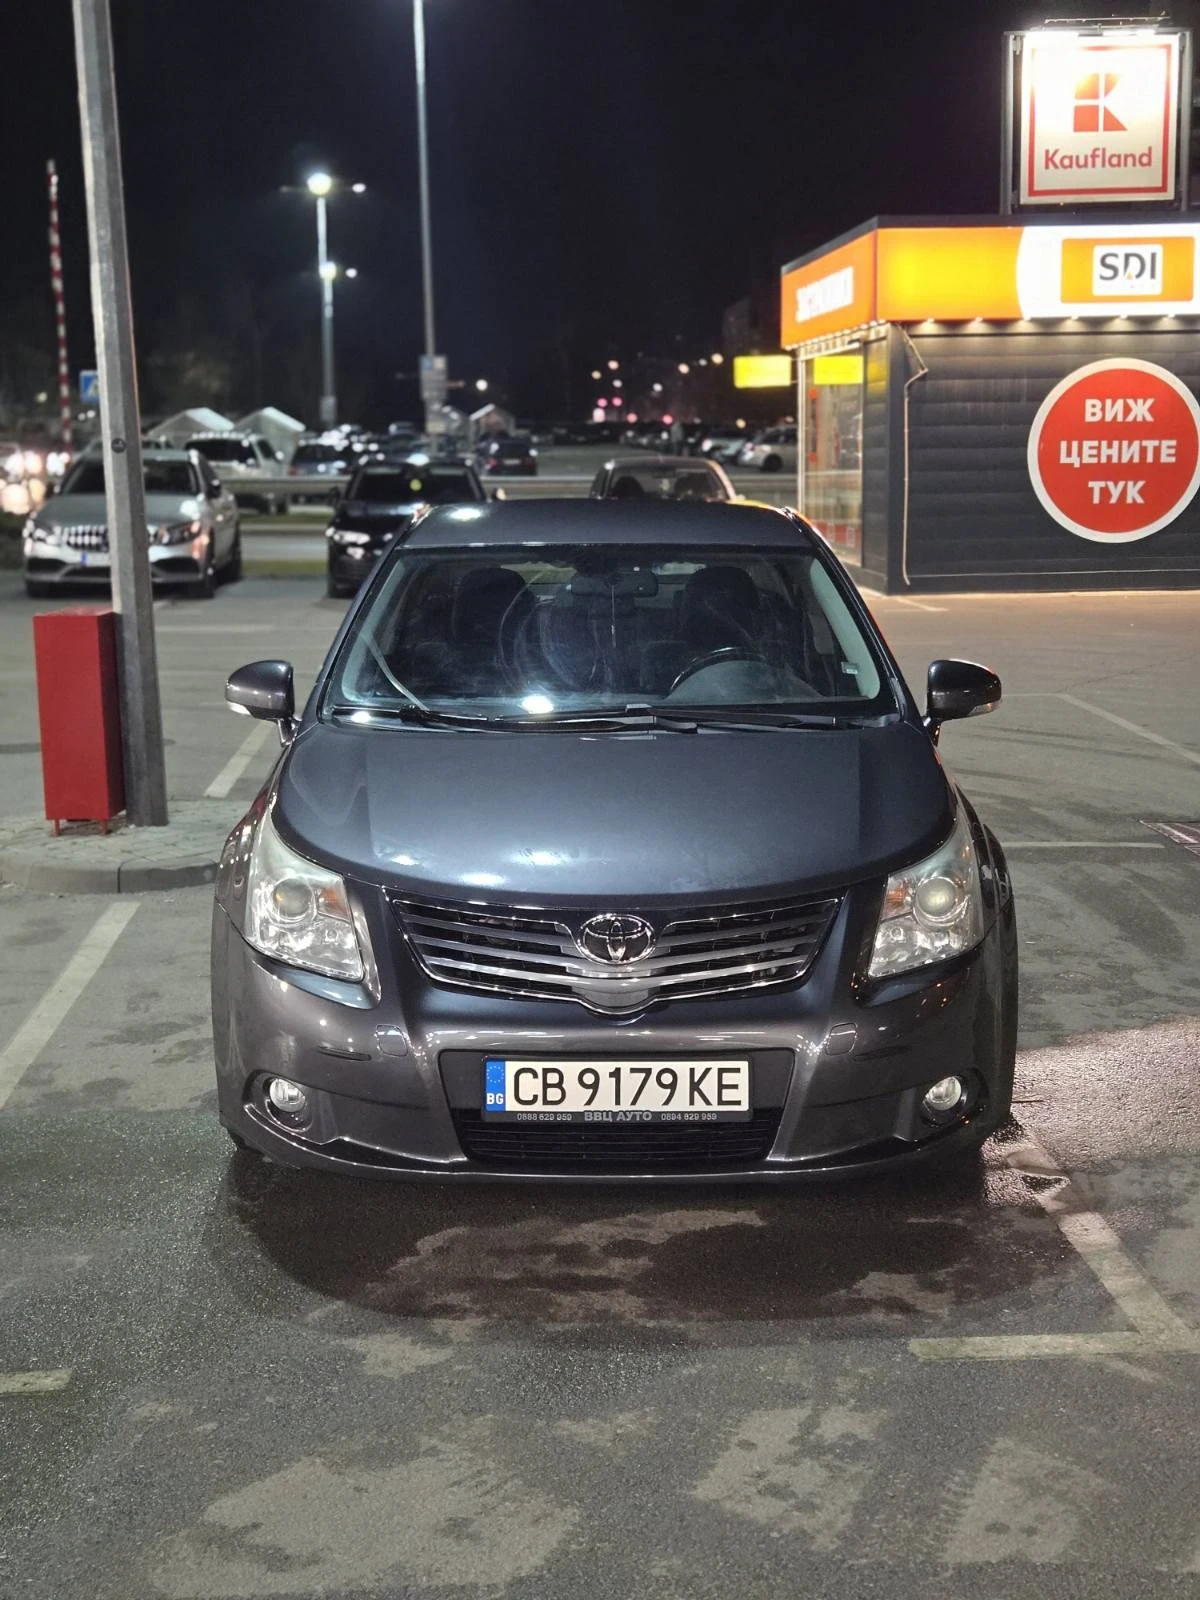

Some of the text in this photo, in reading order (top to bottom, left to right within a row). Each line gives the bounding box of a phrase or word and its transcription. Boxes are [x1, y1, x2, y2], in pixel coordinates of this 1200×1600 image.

[1044, 146, 1152, 170] Kaufland
[1099, 252, 1157, 281] SDI
[1084, 398, 1155, 423] ВИЖ
[1059, 440, 1177, 468] ЦЕНИТЕ
[1088, 481, 1146, 504] ТУК
[486, 1092, 504, 1105] BG
[513, 1067, 742, 1106] CB 9179 KE
[616, 1111, 652, 1121] АУТО
